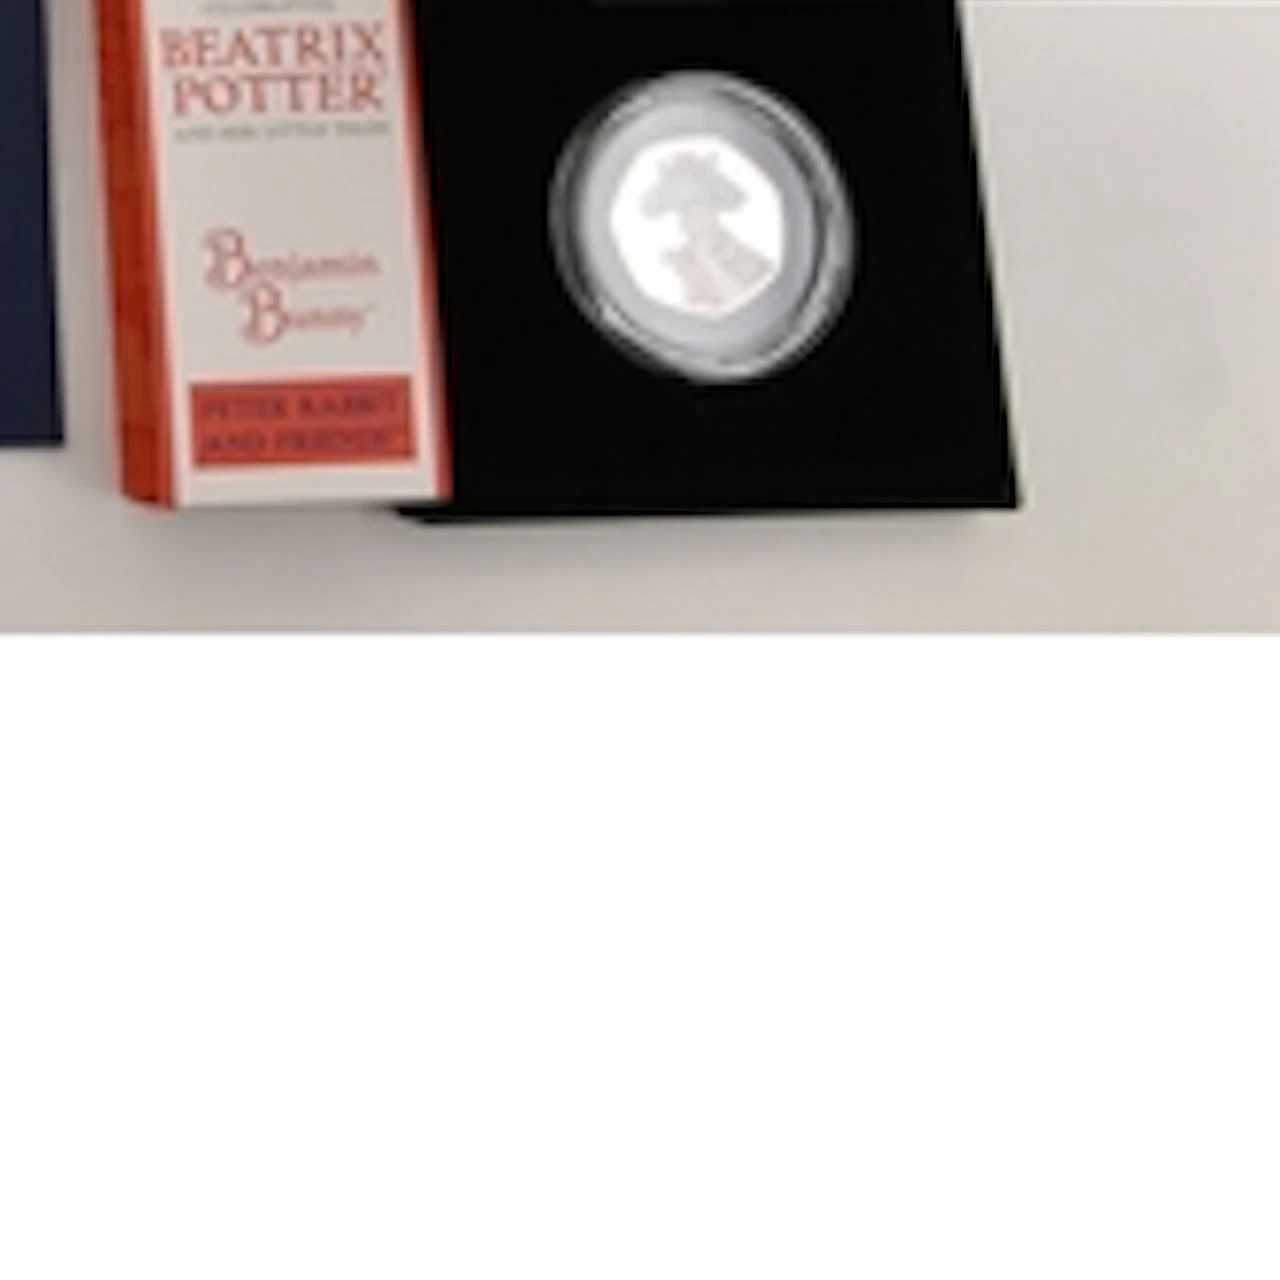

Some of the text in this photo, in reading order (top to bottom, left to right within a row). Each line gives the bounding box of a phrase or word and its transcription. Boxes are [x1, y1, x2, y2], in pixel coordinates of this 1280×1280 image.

[160, 21, 387, 69] BEATRIX
[171, 70, 385, 118] POTTER
[203, 227, 380, 293] Benjamin
